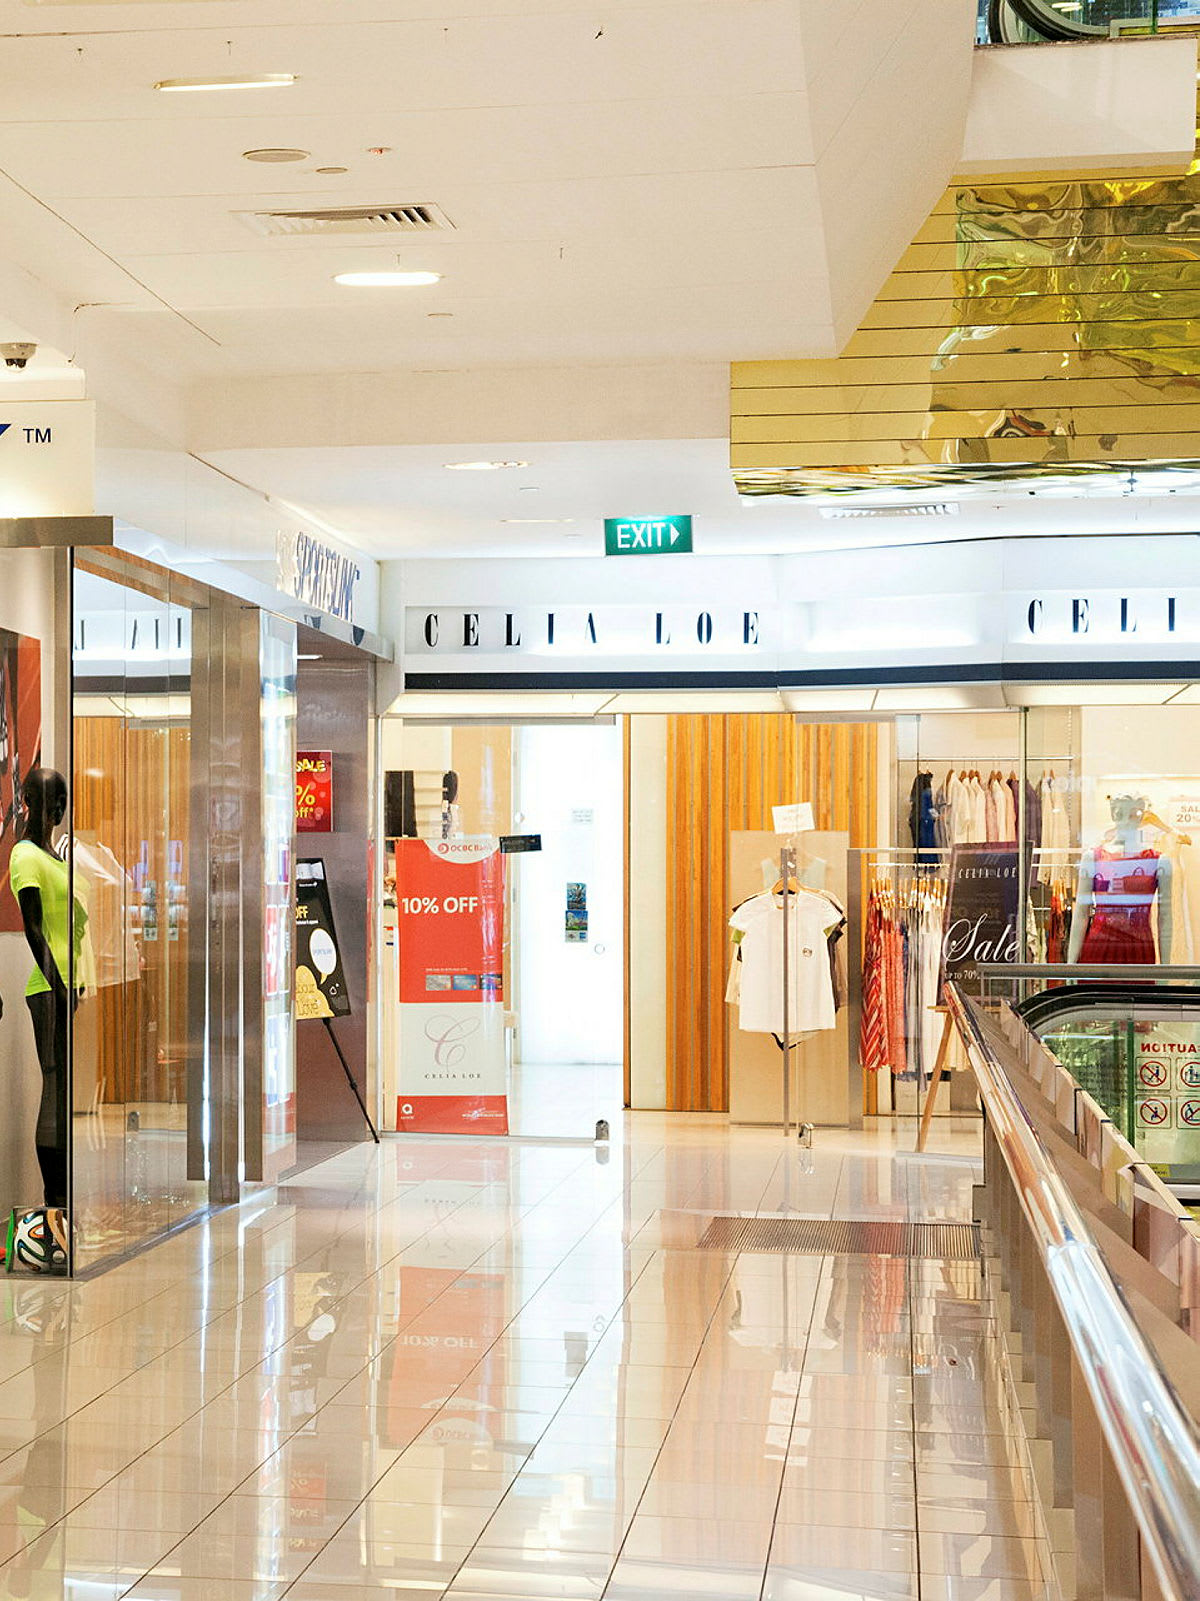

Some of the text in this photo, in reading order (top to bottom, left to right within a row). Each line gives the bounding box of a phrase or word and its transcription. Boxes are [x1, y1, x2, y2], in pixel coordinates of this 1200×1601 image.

[22, 427, 52, 444] TM
[616, 522, 667, 549] EXIT
[424, 611, 760, 648] CELIA LOE
[401, 896, 479, 914] 10% OFF
[942, 912, 1020, 972] Sale
